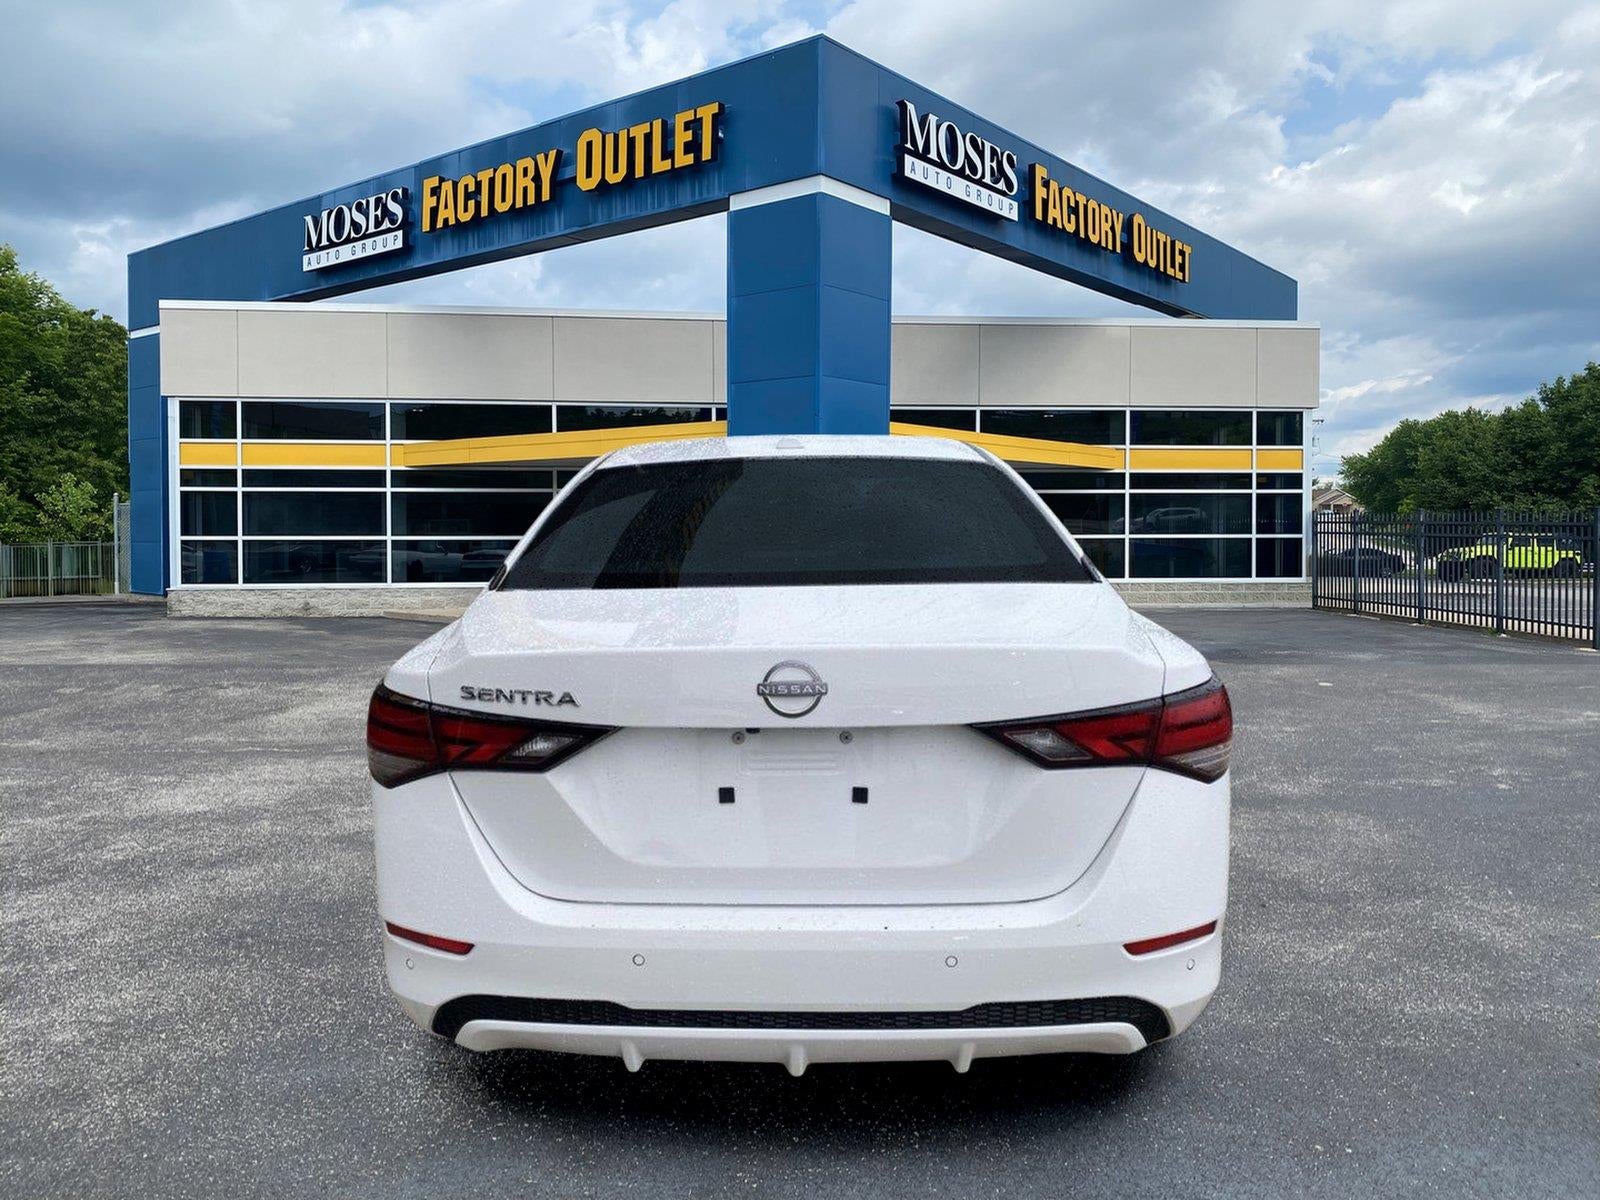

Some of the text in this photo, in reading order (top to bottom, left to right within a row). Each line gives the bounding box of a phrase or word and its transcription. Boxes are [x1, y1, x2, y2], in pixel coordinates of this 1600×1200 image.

[421, 101, 721, 233] FACTORY OUTLET
[904, 99, 1019, 196] MOSES
[909, 160, 1015, 214] AUTO GROUP
[303, 188, 404, 251] MOSES
[1034, 163, 1192, 283] FACTORY OUTLET
[307, 234, 400, 268] AUTO GROUP
[460, 685, 581, 707] SENTRA
[758, 683, 827, 696] NISSAN
